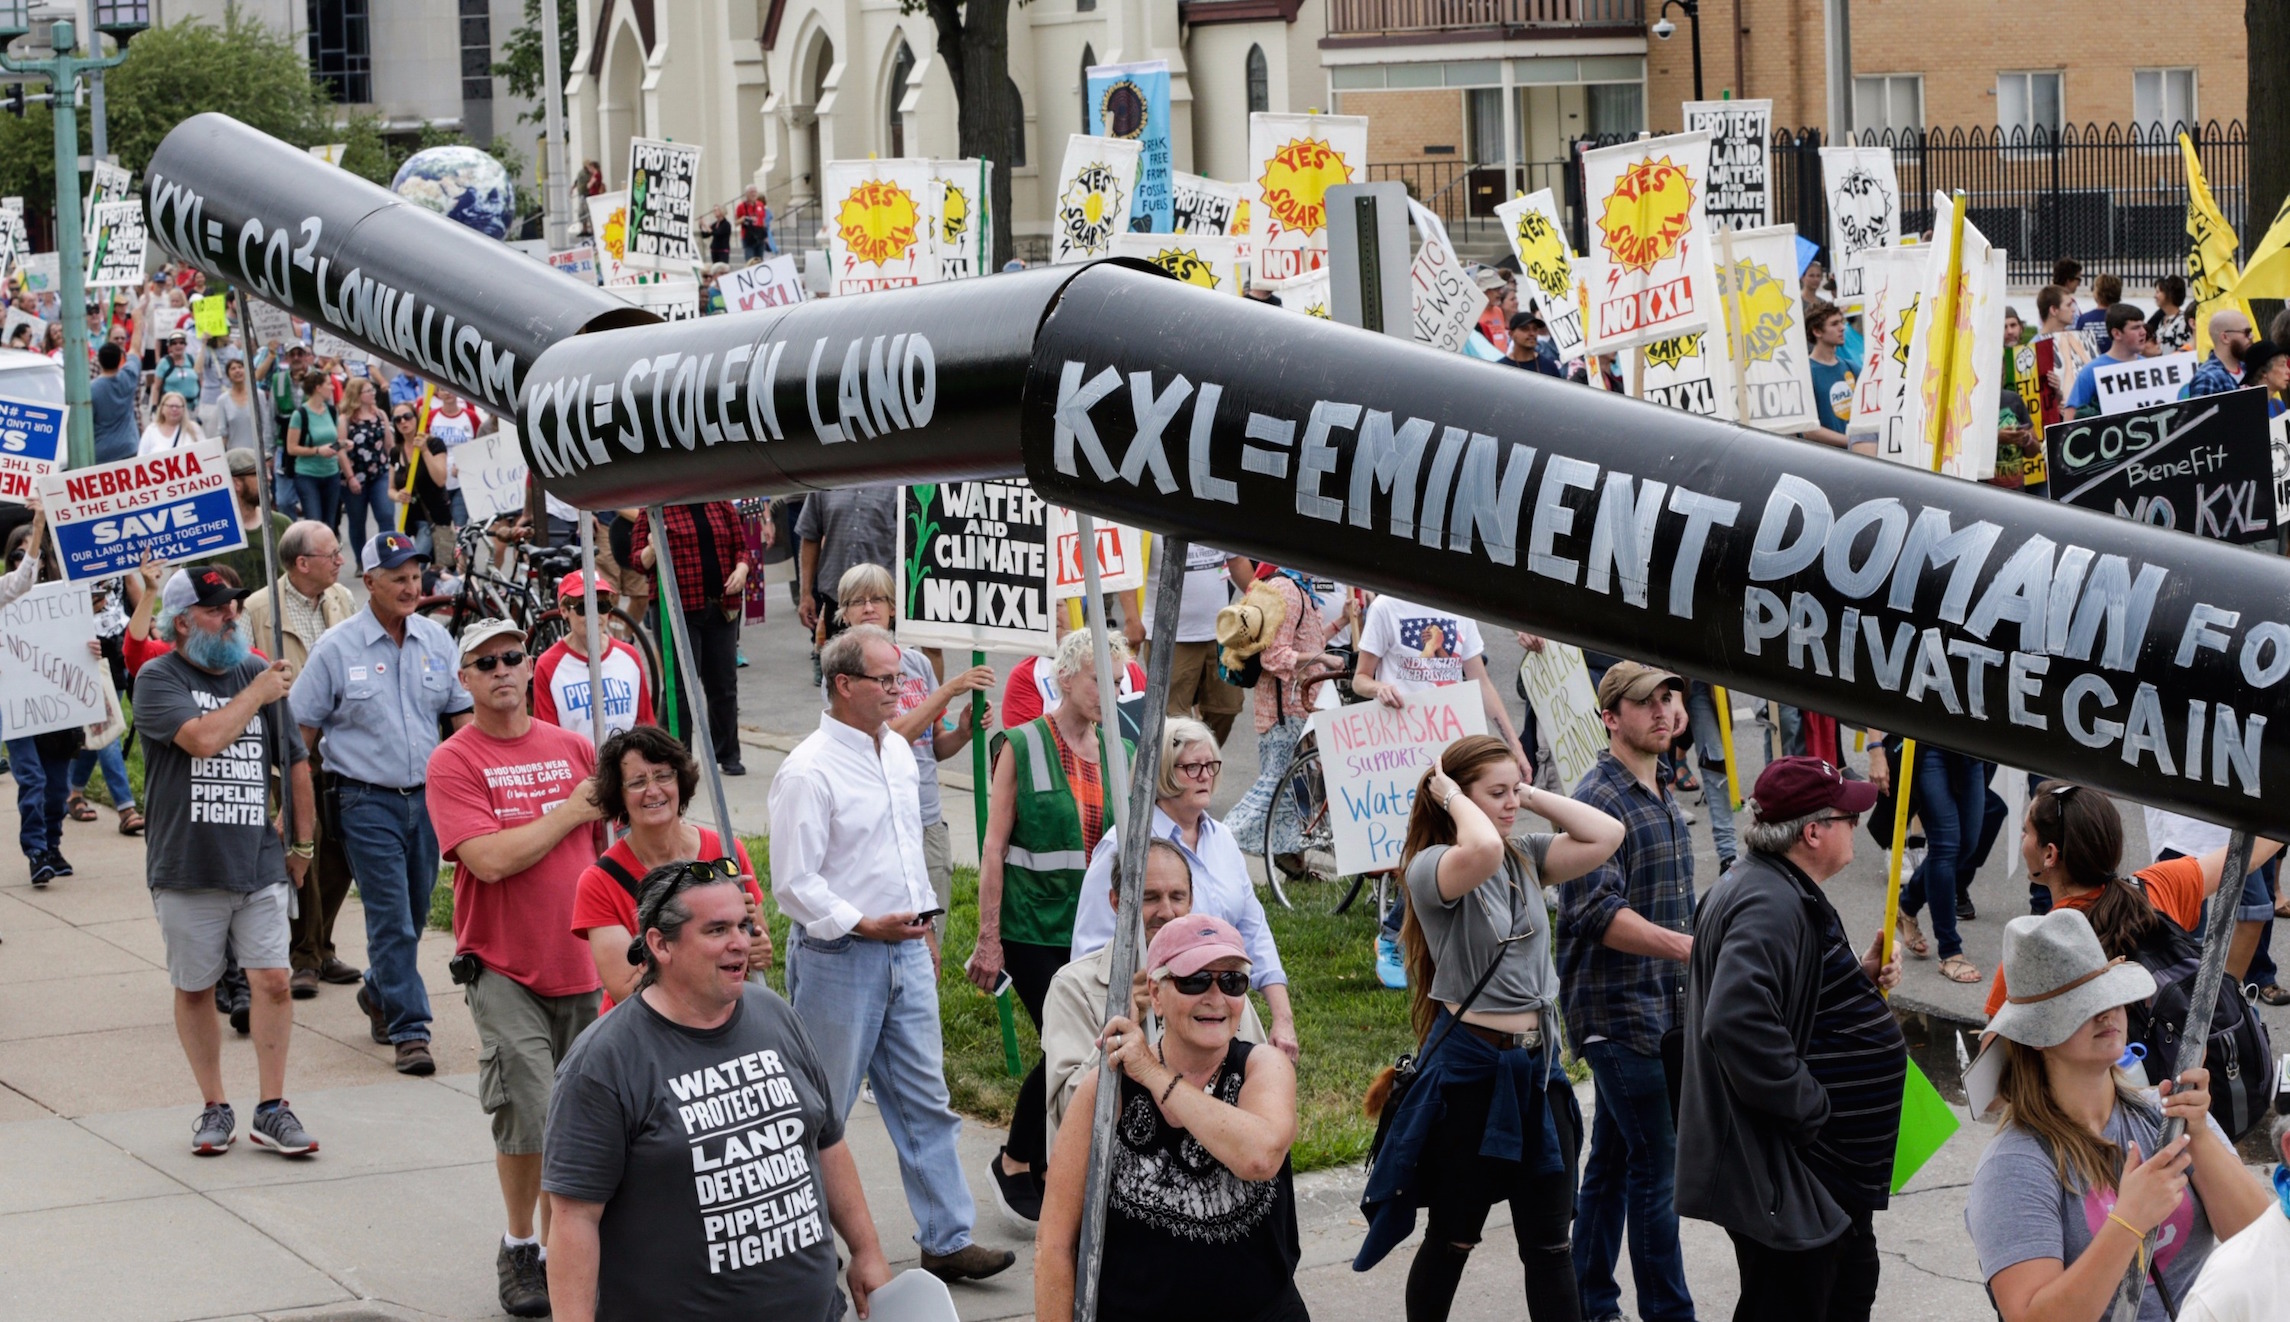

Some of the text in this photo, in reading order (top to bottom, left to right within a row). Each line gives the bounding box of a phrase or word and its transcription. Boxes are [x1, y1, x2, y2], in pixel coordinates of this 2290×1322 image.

[1693, 111, 1765, 138] PROTECT
[635, 146, 695, 176] PROTECT
[1146, 168, 1168, 181] FROM
[1149, 153, 1169, 165] FREE
[1277, 146, 1330, 173] YES
[1709, 164, 1763, 185] WATER
[851, 187, 898, 211] YES
[1079, 171, 1111, 193] YES
[1139, 185, 1168, 198] FOSSIL
[1617, 167, 1672, 203] YES
[1720, 184, 1746, 192] AND
[1843, 175, 1872, 199] YES
[646, 193, 690, 215] WATER
[1142, 199, 1169, 213] FUELS
[1172, 186, 1232, 222] PROTECT
[1270, 188, 1319, 227] SOLAR
[1706, 192, 1764, 210] CLIMATE
[642, 216, 688, 239] CLIMATE
[845, 225, 911, 258] SOLAR XL
[1068, 207, 1098, 246] SOLAR
[1521, 217, 1545, 244] YES
[1611, 213, 1685, 263] SOLAR XL
[637, 234, 657, 255] NO
[659, 235, 690, 261] KXL
[1264, 250, 1297, 279] NO
[737, 264, 773, 293] NO
[1602, 281, 1693, 338] NO KXL
[806, 332, 937, 446] LAND
[2100, 364, 2181, 395] THERE
[2062, 408, 2180, 468] COST
[66, 451, 202, 503] NEBRASKA
[56, 474, 223, 521] IS THE LAST STAND
[940, 480, 1047, 526] WATER
[2114, 479, 2268, 539] NO KXL
[71, 518, 229, 562] OUR LAND & WATER TOGETHER
[92, 501, 200, 545] SAVE
[964, 519, 1008, 538] AND
[934, 534, 1045, 577] CLIMATE
[1749, 473, 2169, 673] DOMAIN
[4, 590, 88, 627] ROTECT
[923, 577, 1048, 631] NO KXL
[6, 633, 99, 709] NDIGENOUS
[191, 690, 233, 710] WAT
[563, 677, 632, 711] PIPLINE
[1743, 585, 2268, 798] PRIVATE GAIN
[9, 693, 70, 731] LANDS
[1550, 687, 1579, 733] FOR
[1332, 704, 1466, 754] NEBRASKA
[1555, 709, 1609, 783] STANDIN
[191, 757, 263, 780] DEFENDER
[487, 768, 572, 788] INVISIBLE CAPES
[509, 762, 543, 775] DONORS
[544, 759, 569, 769] WEAR
[191, 783, 264, 804] PIPELINE
[1341, 780, 1415, 822] Wate
[191, 802, 265, 826] FIGHTER
[668, 1049, 786, 1102] WATER
[678, 1076, 799, 1135] PROTECTOR
[691, 1117, 805, 1173] LAND
[695, 1144, 810, 1206] DEFENDER
[704, 1182, 818, 1241] PIPELINE
[708, 1210, 823, 1274] FIGHTER
